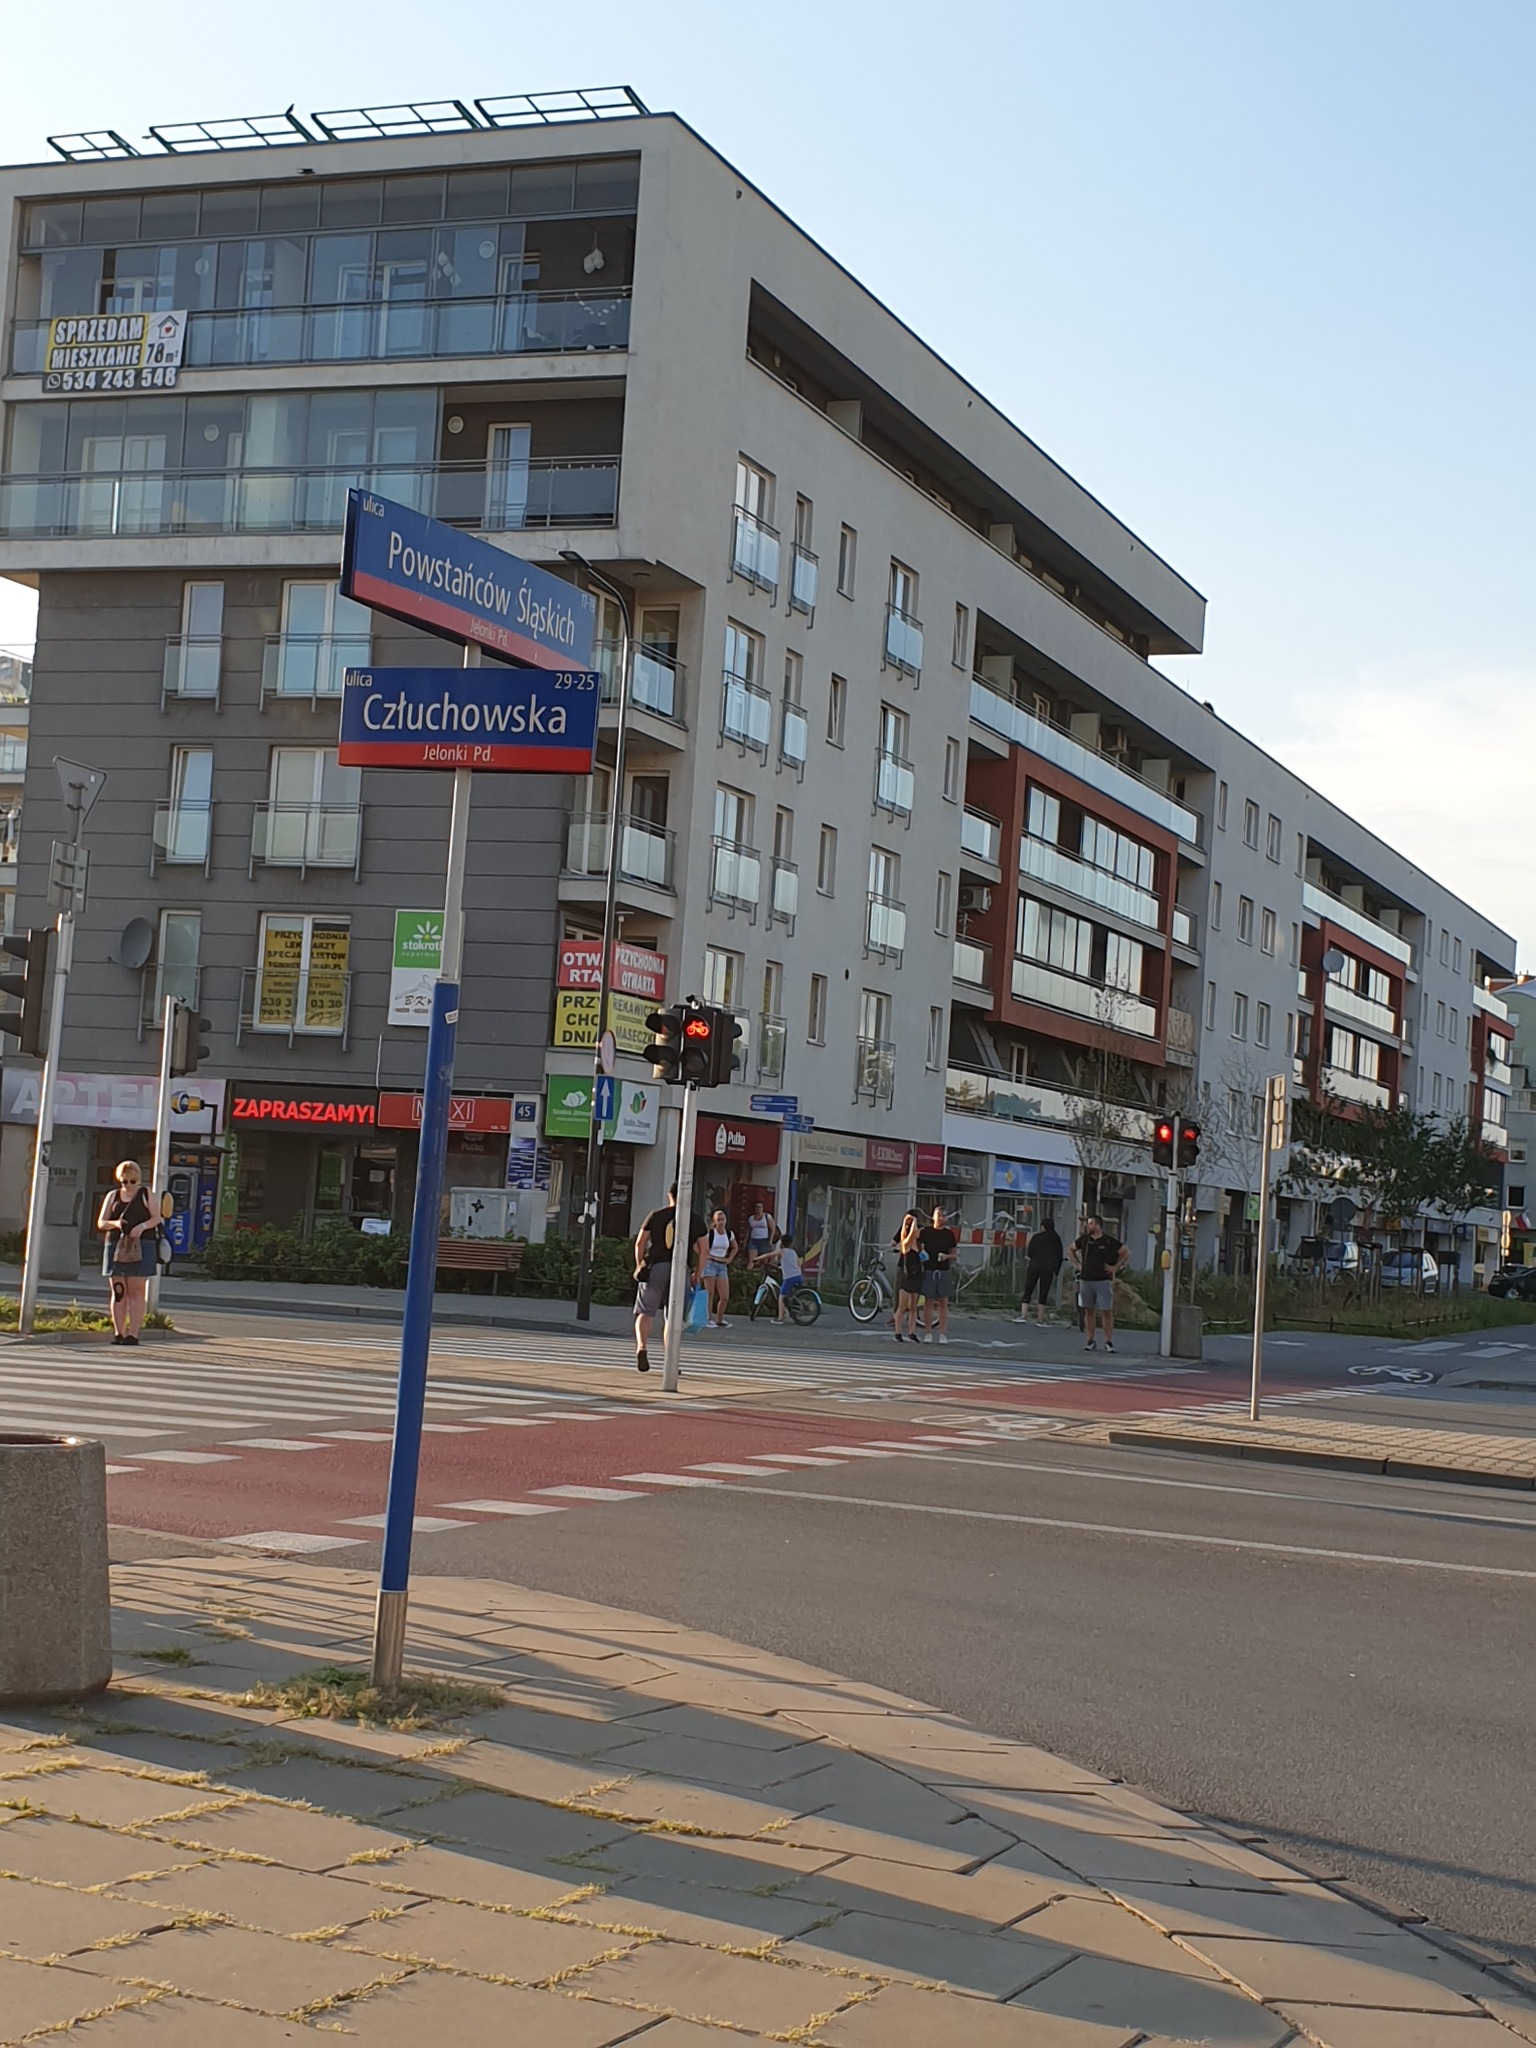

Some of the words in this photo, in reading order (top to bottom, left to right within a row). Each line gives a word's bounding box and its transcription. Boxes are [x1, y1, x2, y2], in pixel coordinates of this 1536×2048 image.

[55, 317, 144, 343] SPRZEDAM
[51, 343, 141, 369] MIESZKANIE
[146, 343, 165, 363] 78
[62, 371, 96, 391] 534
[101, 369, 135, 389] 243
[141, 367, 176, 387] 548
[363, 495, 385, 518] ulica
[388, 531, 511, 616] Powstańców
[517, 578, 575, 646] Śląskich
[470, 617, 497, 640] Jelonki
[346, 671, 372, 687] ulica
[554, 673, 595, 691] 29-25
[363, 692, 567, 734] Człuchowska
[423, 745, 467, 762] Jelonki
[473, 745, 494, 762] Pd.
[402, 939, 441, 951] stokrot
[563, 952, 602, 966] OTW
[616, 946, 665, 975] PRZYCHODNIA
[569, 969, 602, 983] RTA
[622, 971, 656, 995] OTWARTA
[232, 1098, 374, 1124] ZAPRASZAMY!
[416, 1099, 470, 1121] MXI
[518, 1105, 531, 1117] 45
